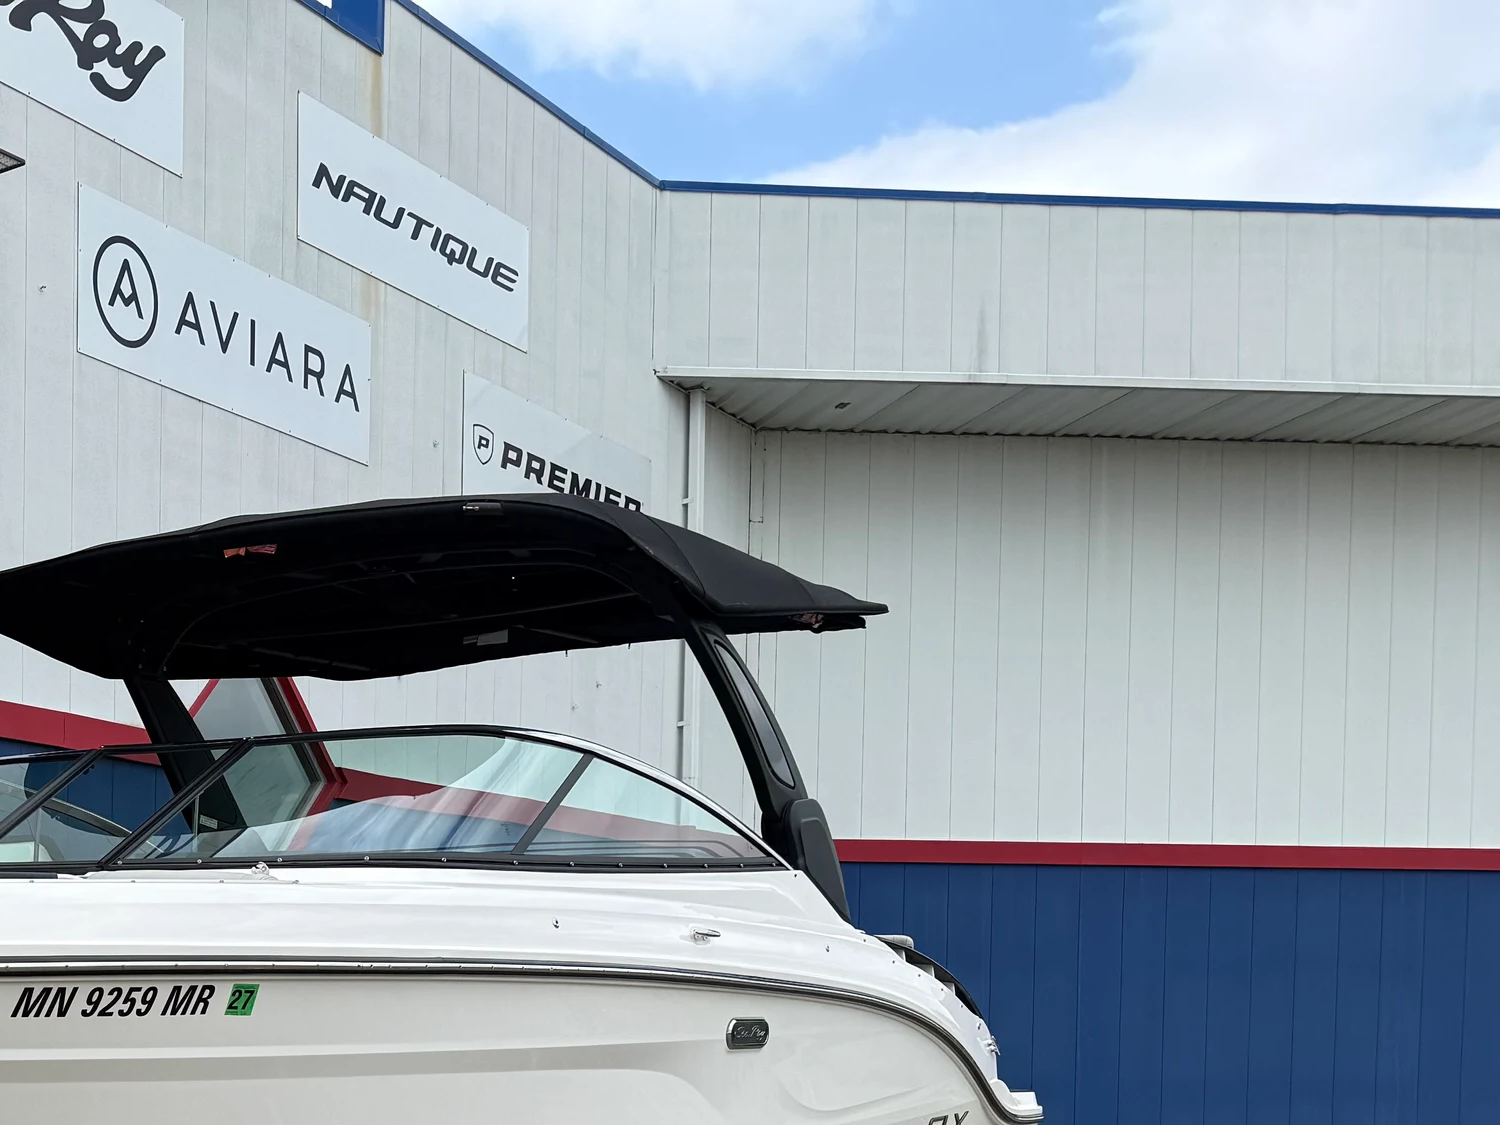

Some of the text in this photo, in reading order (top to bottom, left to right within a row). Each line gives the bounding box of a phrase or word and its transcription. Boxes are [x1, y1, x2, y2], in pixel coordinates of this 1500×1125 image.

[311, 162, 519, 292] NAUTIQUE
[174, 291, 360, 412] AVIARA
[10, 987, 79, 1018] MN
[81, 986, 158, 1018] 9259
[161, 985, 216, 1016] MR
[227, 989, 256, 1011] 27
